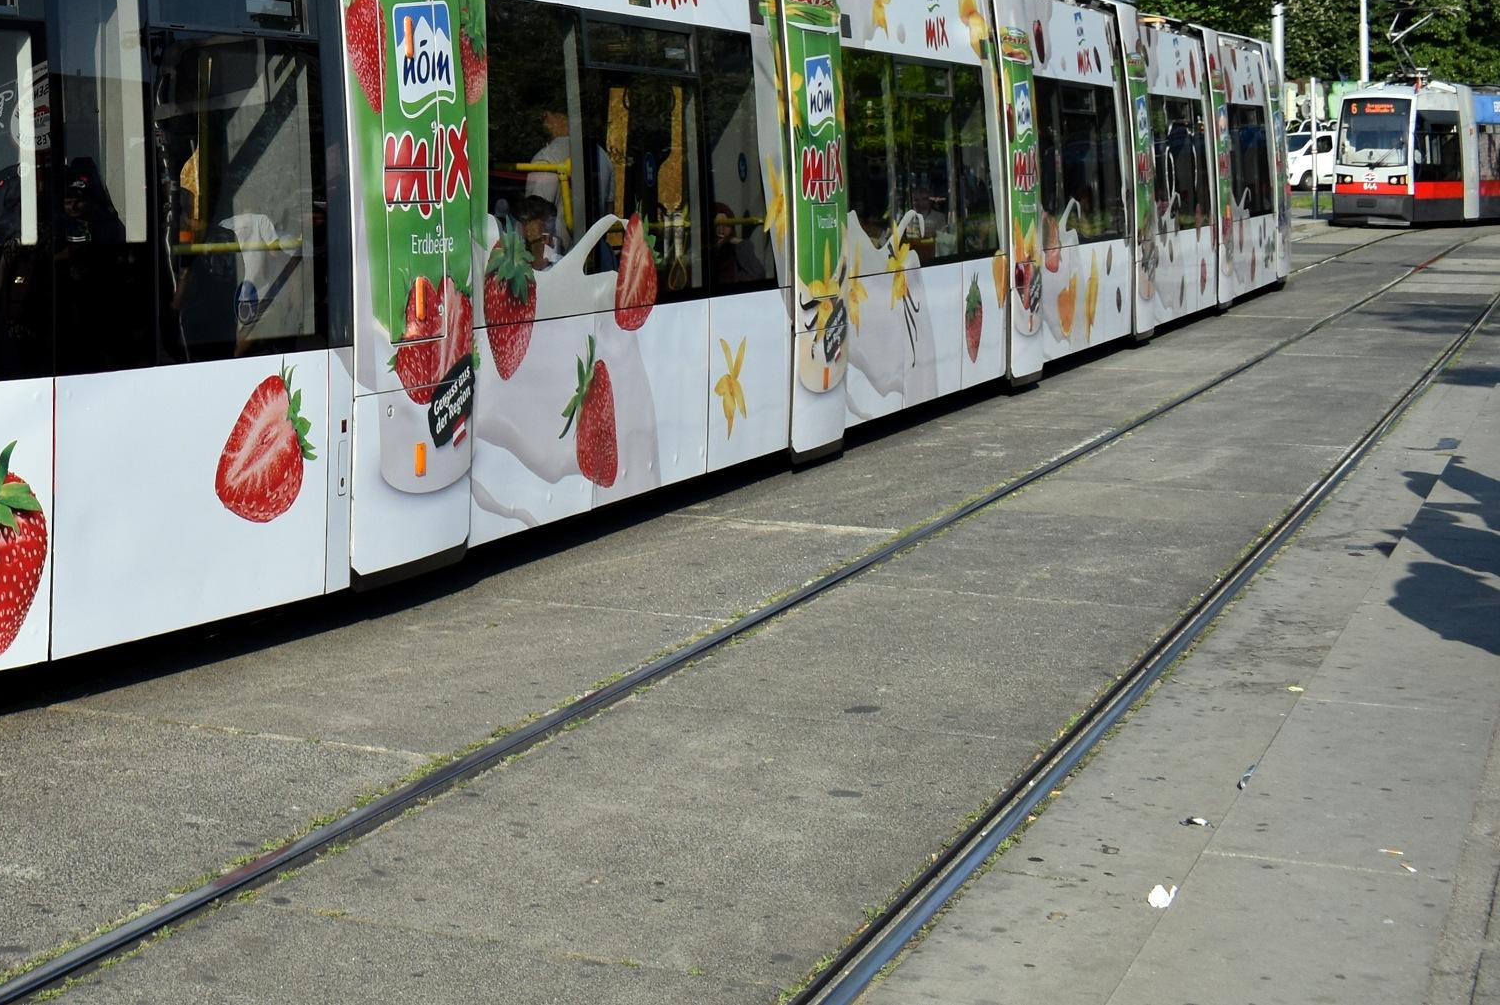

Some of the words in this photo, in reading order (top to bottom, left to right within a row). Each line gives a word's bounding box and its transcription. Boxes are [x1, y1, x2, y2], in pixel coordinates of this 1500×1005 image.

[1351, 103, 1358, 115] 6
[411, 234, 454, 256] Erdbeere
[436, 412, 449, 435] der
